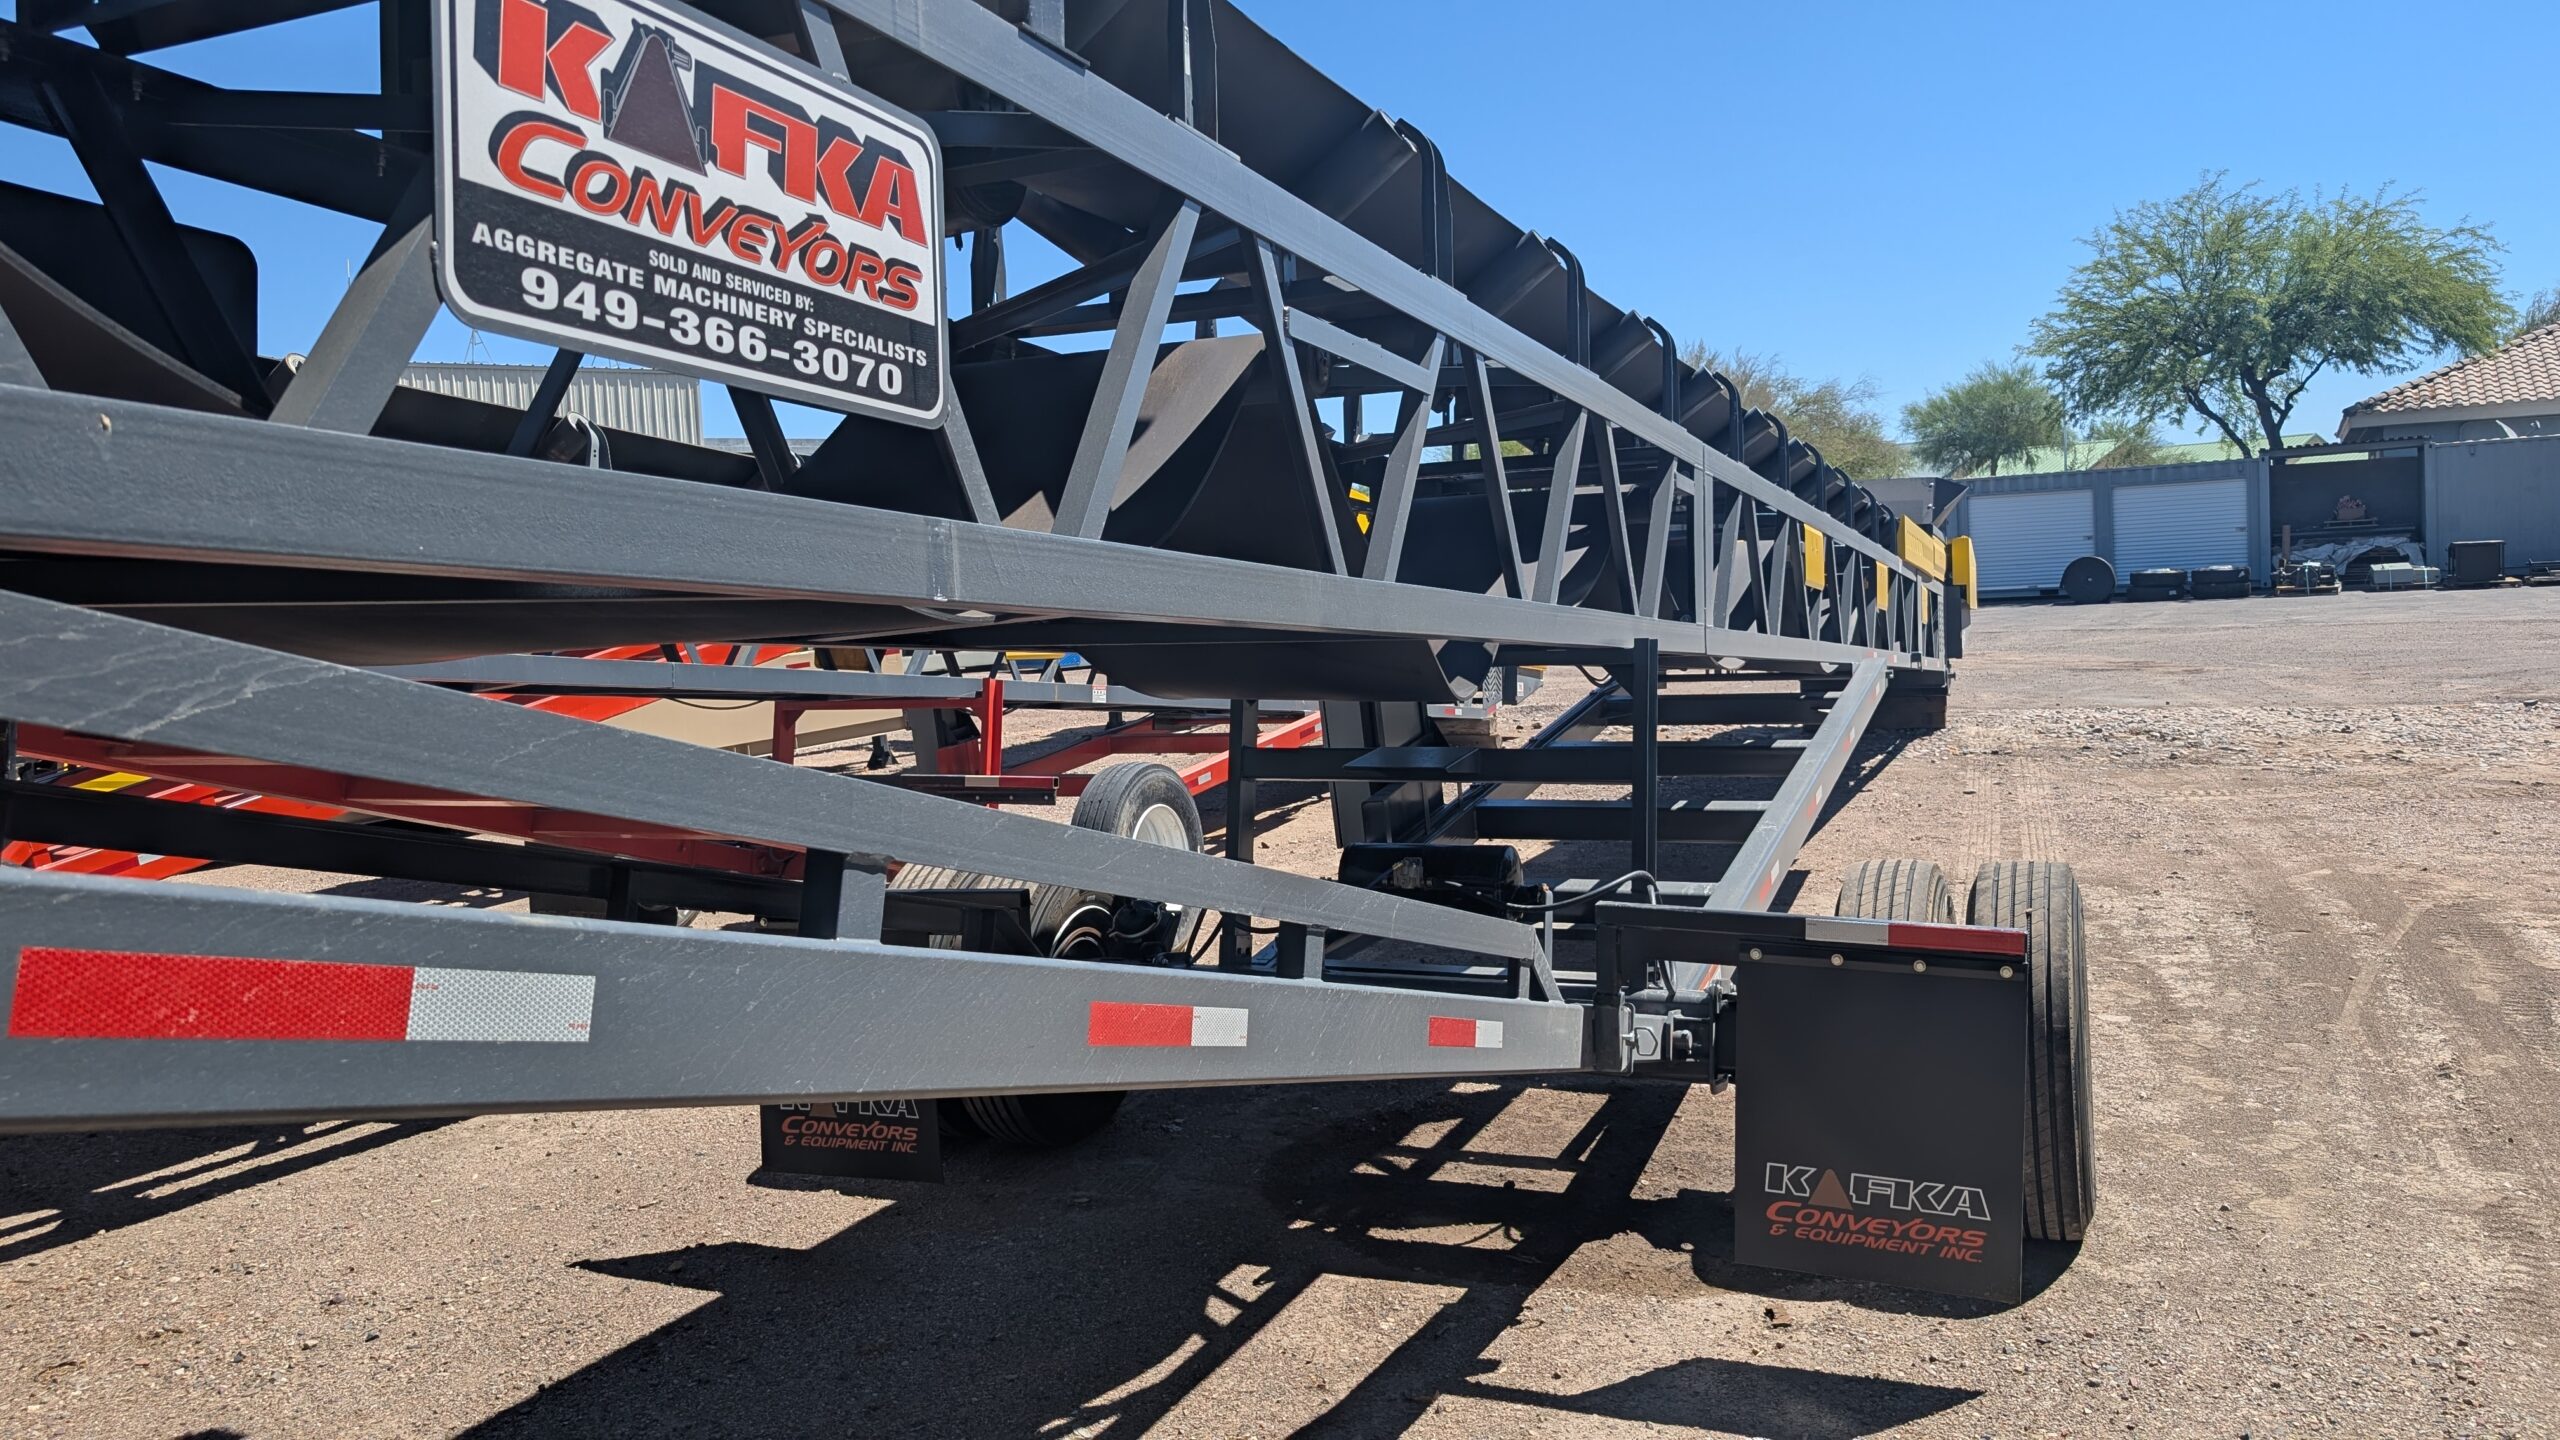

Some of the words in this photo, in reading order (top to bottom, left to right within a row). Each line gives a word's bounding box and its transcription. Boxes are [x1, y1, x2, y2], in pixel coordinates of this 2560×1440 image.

[475, 0, 928, 248] KAFKA
[489, 110, 923, 311] CONVEYORS
[472, 222, 644, 289] AGGREGATE
[654, 274, 797, 331] MACHINERY
[803, 317, 928, 367] SPECIALISTS
[648, 249, 688, 275] SOLD
[692, 261, 722, 284] AND
[725, 273, 792, 306] SERVICED
[795, 293, 815, 313] BY:
[521, 267, 903, 396] 949-366-3070
[781, 1115, 919, 1141] CONVEYORS
[784, 1136, 796, 1146] &
[801, 1136, 889, 1152] EQUIPMENT
[1765, 1163, 1991, 1220] KAFKA
[1766, 1201, 1987, 1246] CONVEYORS
[1769, 1224, 1787, 1236] &
[1794, 1227, 1934, 1255] EQUIPMENT
[1940, 1248, 1983, 1262] INC.
